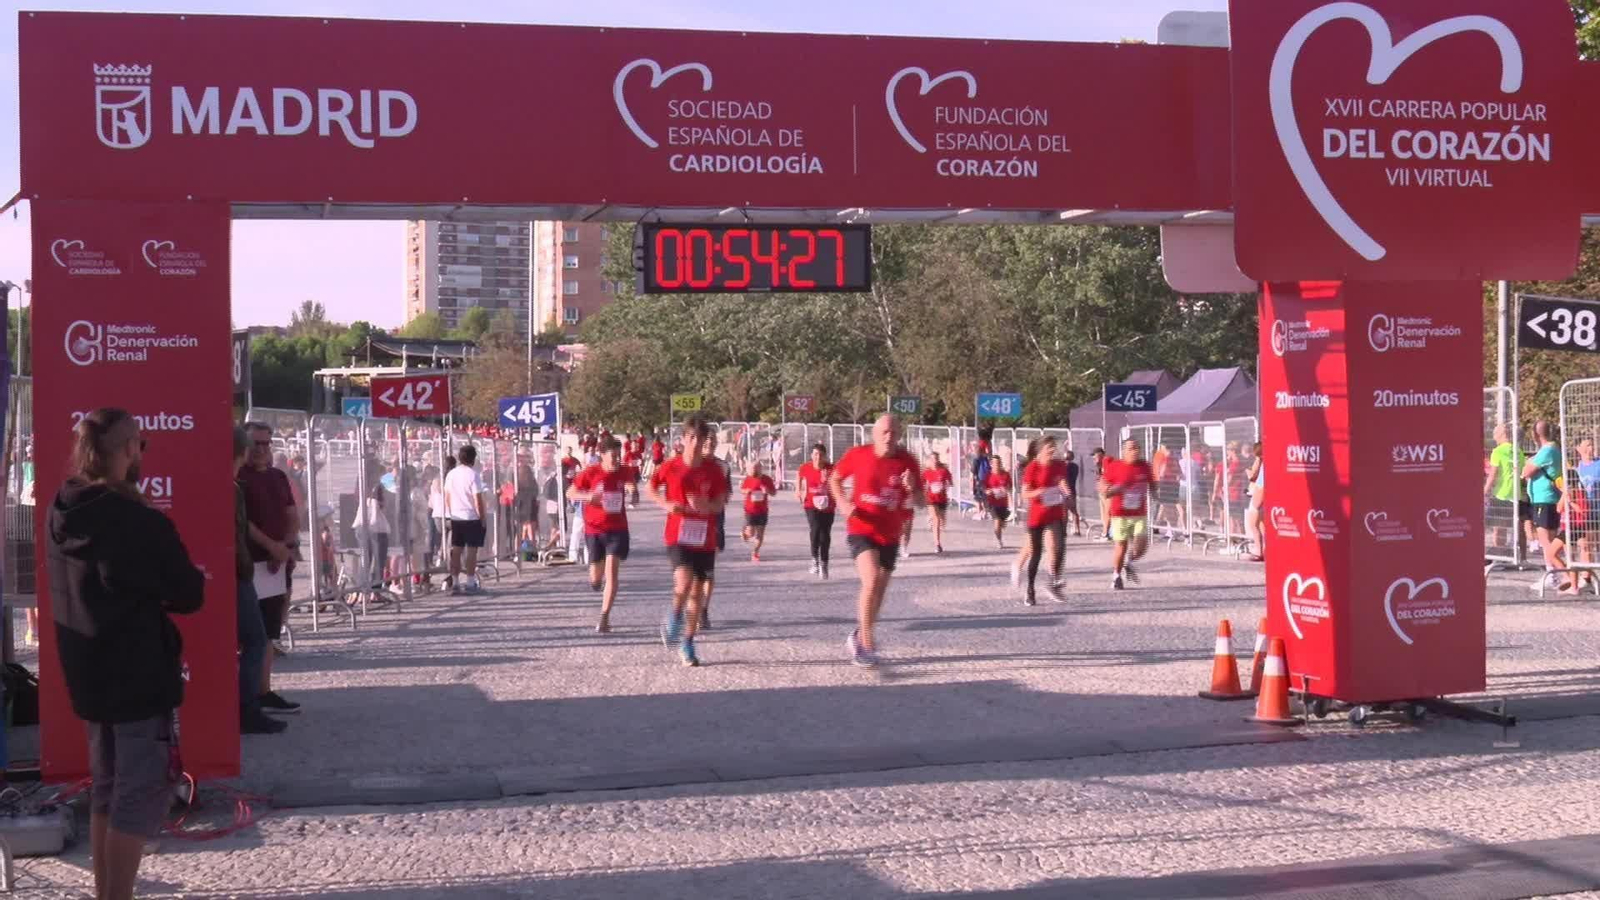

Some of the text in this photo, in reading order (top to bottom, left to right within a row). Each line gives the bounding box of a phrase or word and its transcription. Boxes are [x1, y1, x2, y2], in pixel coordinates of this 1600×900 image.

[171, 86, 418, 149] MADRID
[667, 99, 773, 120] SOCIEDAD
[934, 104, 1049, 127] FUNDACIÓN
[1324, 97, 1548, 122] XVII CARRERA POPULAR
[667, 124, 804, 148] ESPAÑOLA DE
[934, 130, 1071, 153] ESPAÑOLA DEL
[1322, 124, 1551, 162] DEL CORAZÓN
[668, 152, 824, 175] CARDIOLOGÍA
[935, 155, 1040, 178] CORAZÓN
[1384, 167, 1494, 188] VII VIRTUAL
[654, 228, 846, 289] 00:54:27
[106, 324, 156, 334] Medtronic
[1396, 324, 1462, 338] Denervación
[106, 334, 198, 348] Denervación
[1396, 338, 1427, 349] Renal
[106, 349, 148, 361] Renal
[378, 380, 441, 411] <42'
[1274, 391, 1331, 409] 20minutos
[1373, 388, 1459, 408] 20minutos
[70, 411, 195, 431] 2nutos
[502, 399, 551, 424] <45'
[1413, 606, 1456, 617] CORAZÓN
